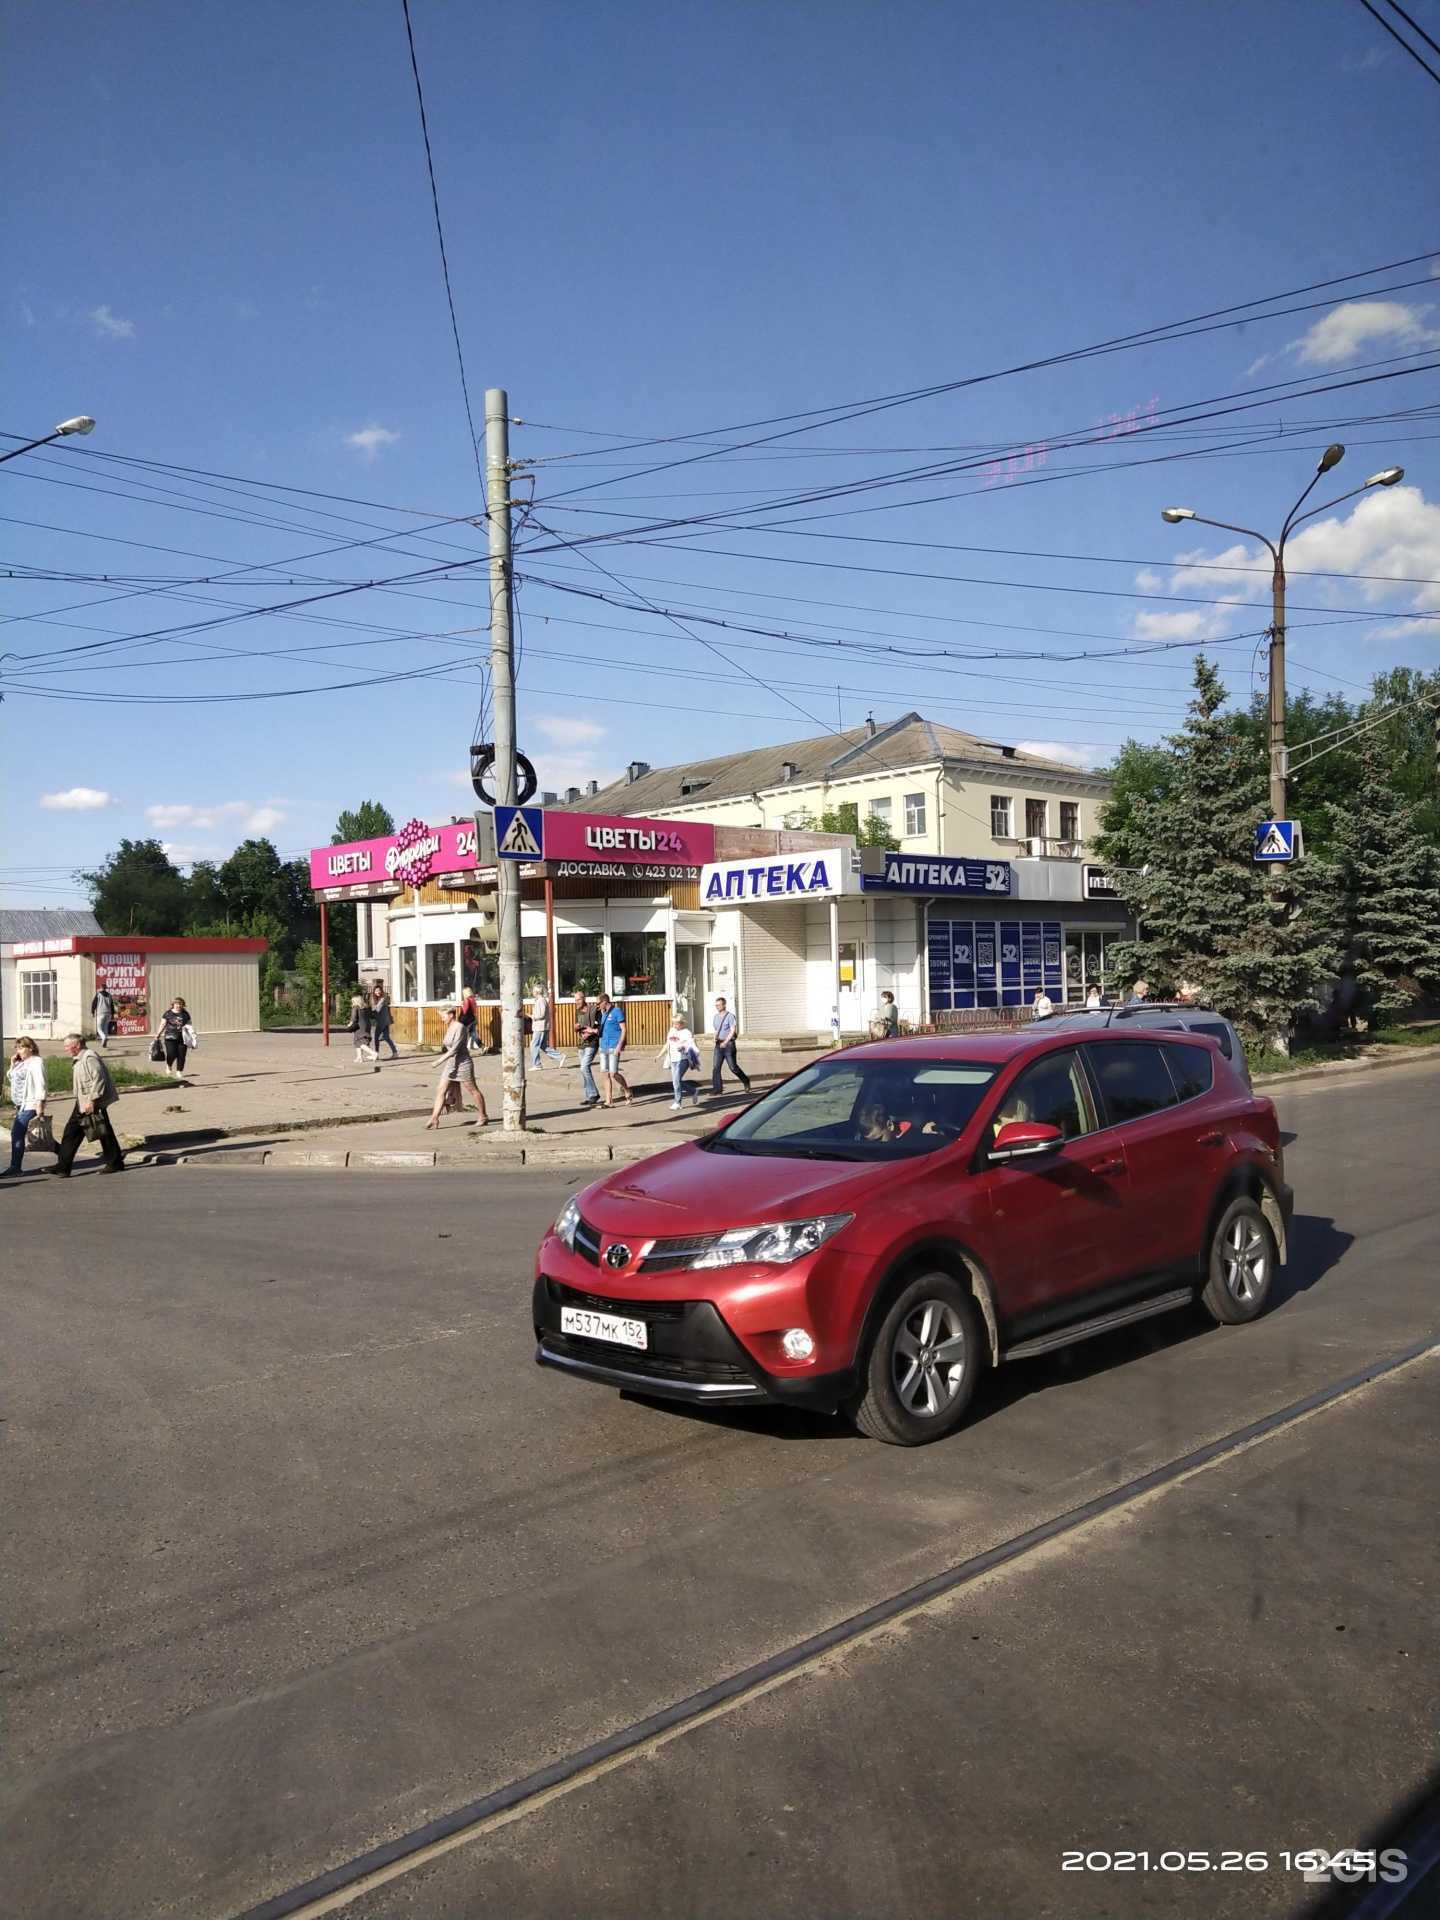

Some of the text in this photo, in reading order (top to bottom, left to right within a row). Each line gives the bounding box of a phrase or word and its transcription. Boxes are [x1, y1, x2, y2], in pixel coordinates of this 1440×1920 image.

[327, 851, 371, 876] ЦВЕТЫ
[557, 862, 698, 879] ДОСТАВКА 423 02 12
[705, 860, 831, 899] АПТЕКА
[886, 862, 1005, 891] АПТЕКА 52
[101, 954, 140, 966] ОВОЩИ
[96, 966, 145, 977] ФРУКТЫ
[105, 977, 136, 988] ОРЕХИ
[621, 1320, 643, 1340] 152
